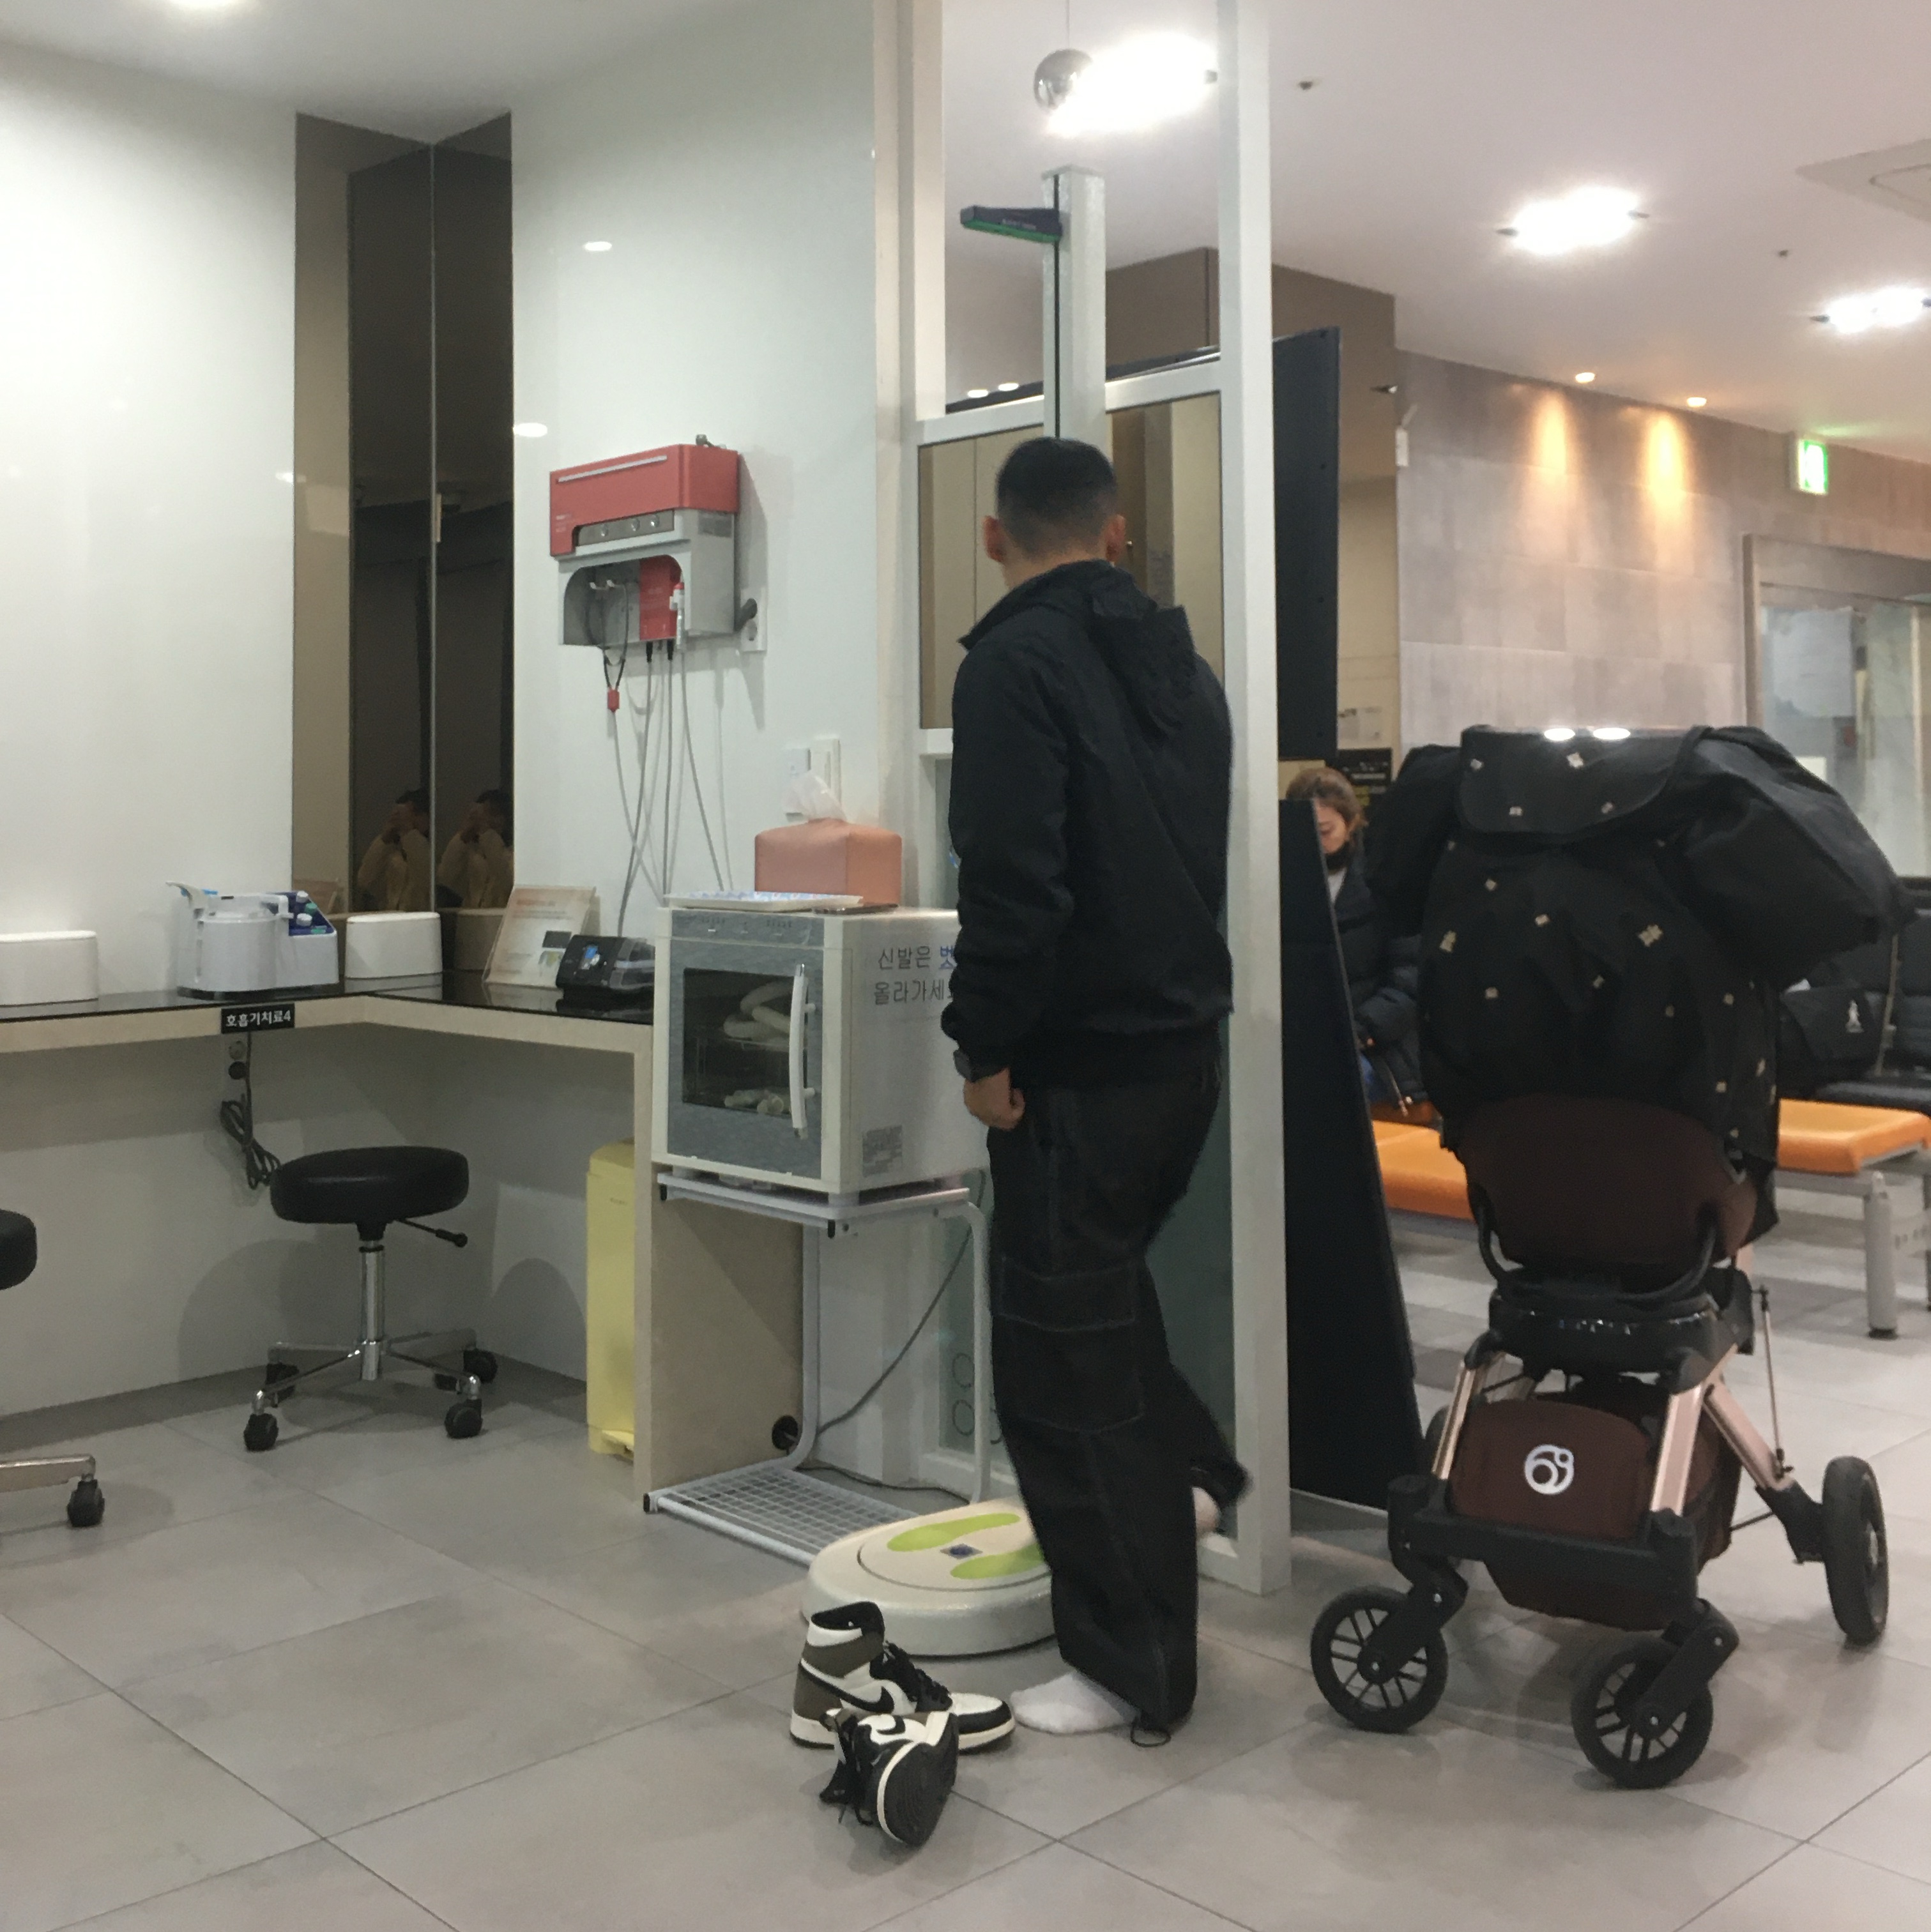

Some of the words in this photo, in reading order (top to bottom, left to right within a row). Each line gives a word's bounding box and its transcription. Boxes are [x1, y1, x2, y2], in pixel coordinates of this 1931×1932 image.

[878, 946, 930, 970] 신발은
[874, 979, 954, 1005] 올라가세
[225, 1010, 291, 1028] 호흡기치료4
